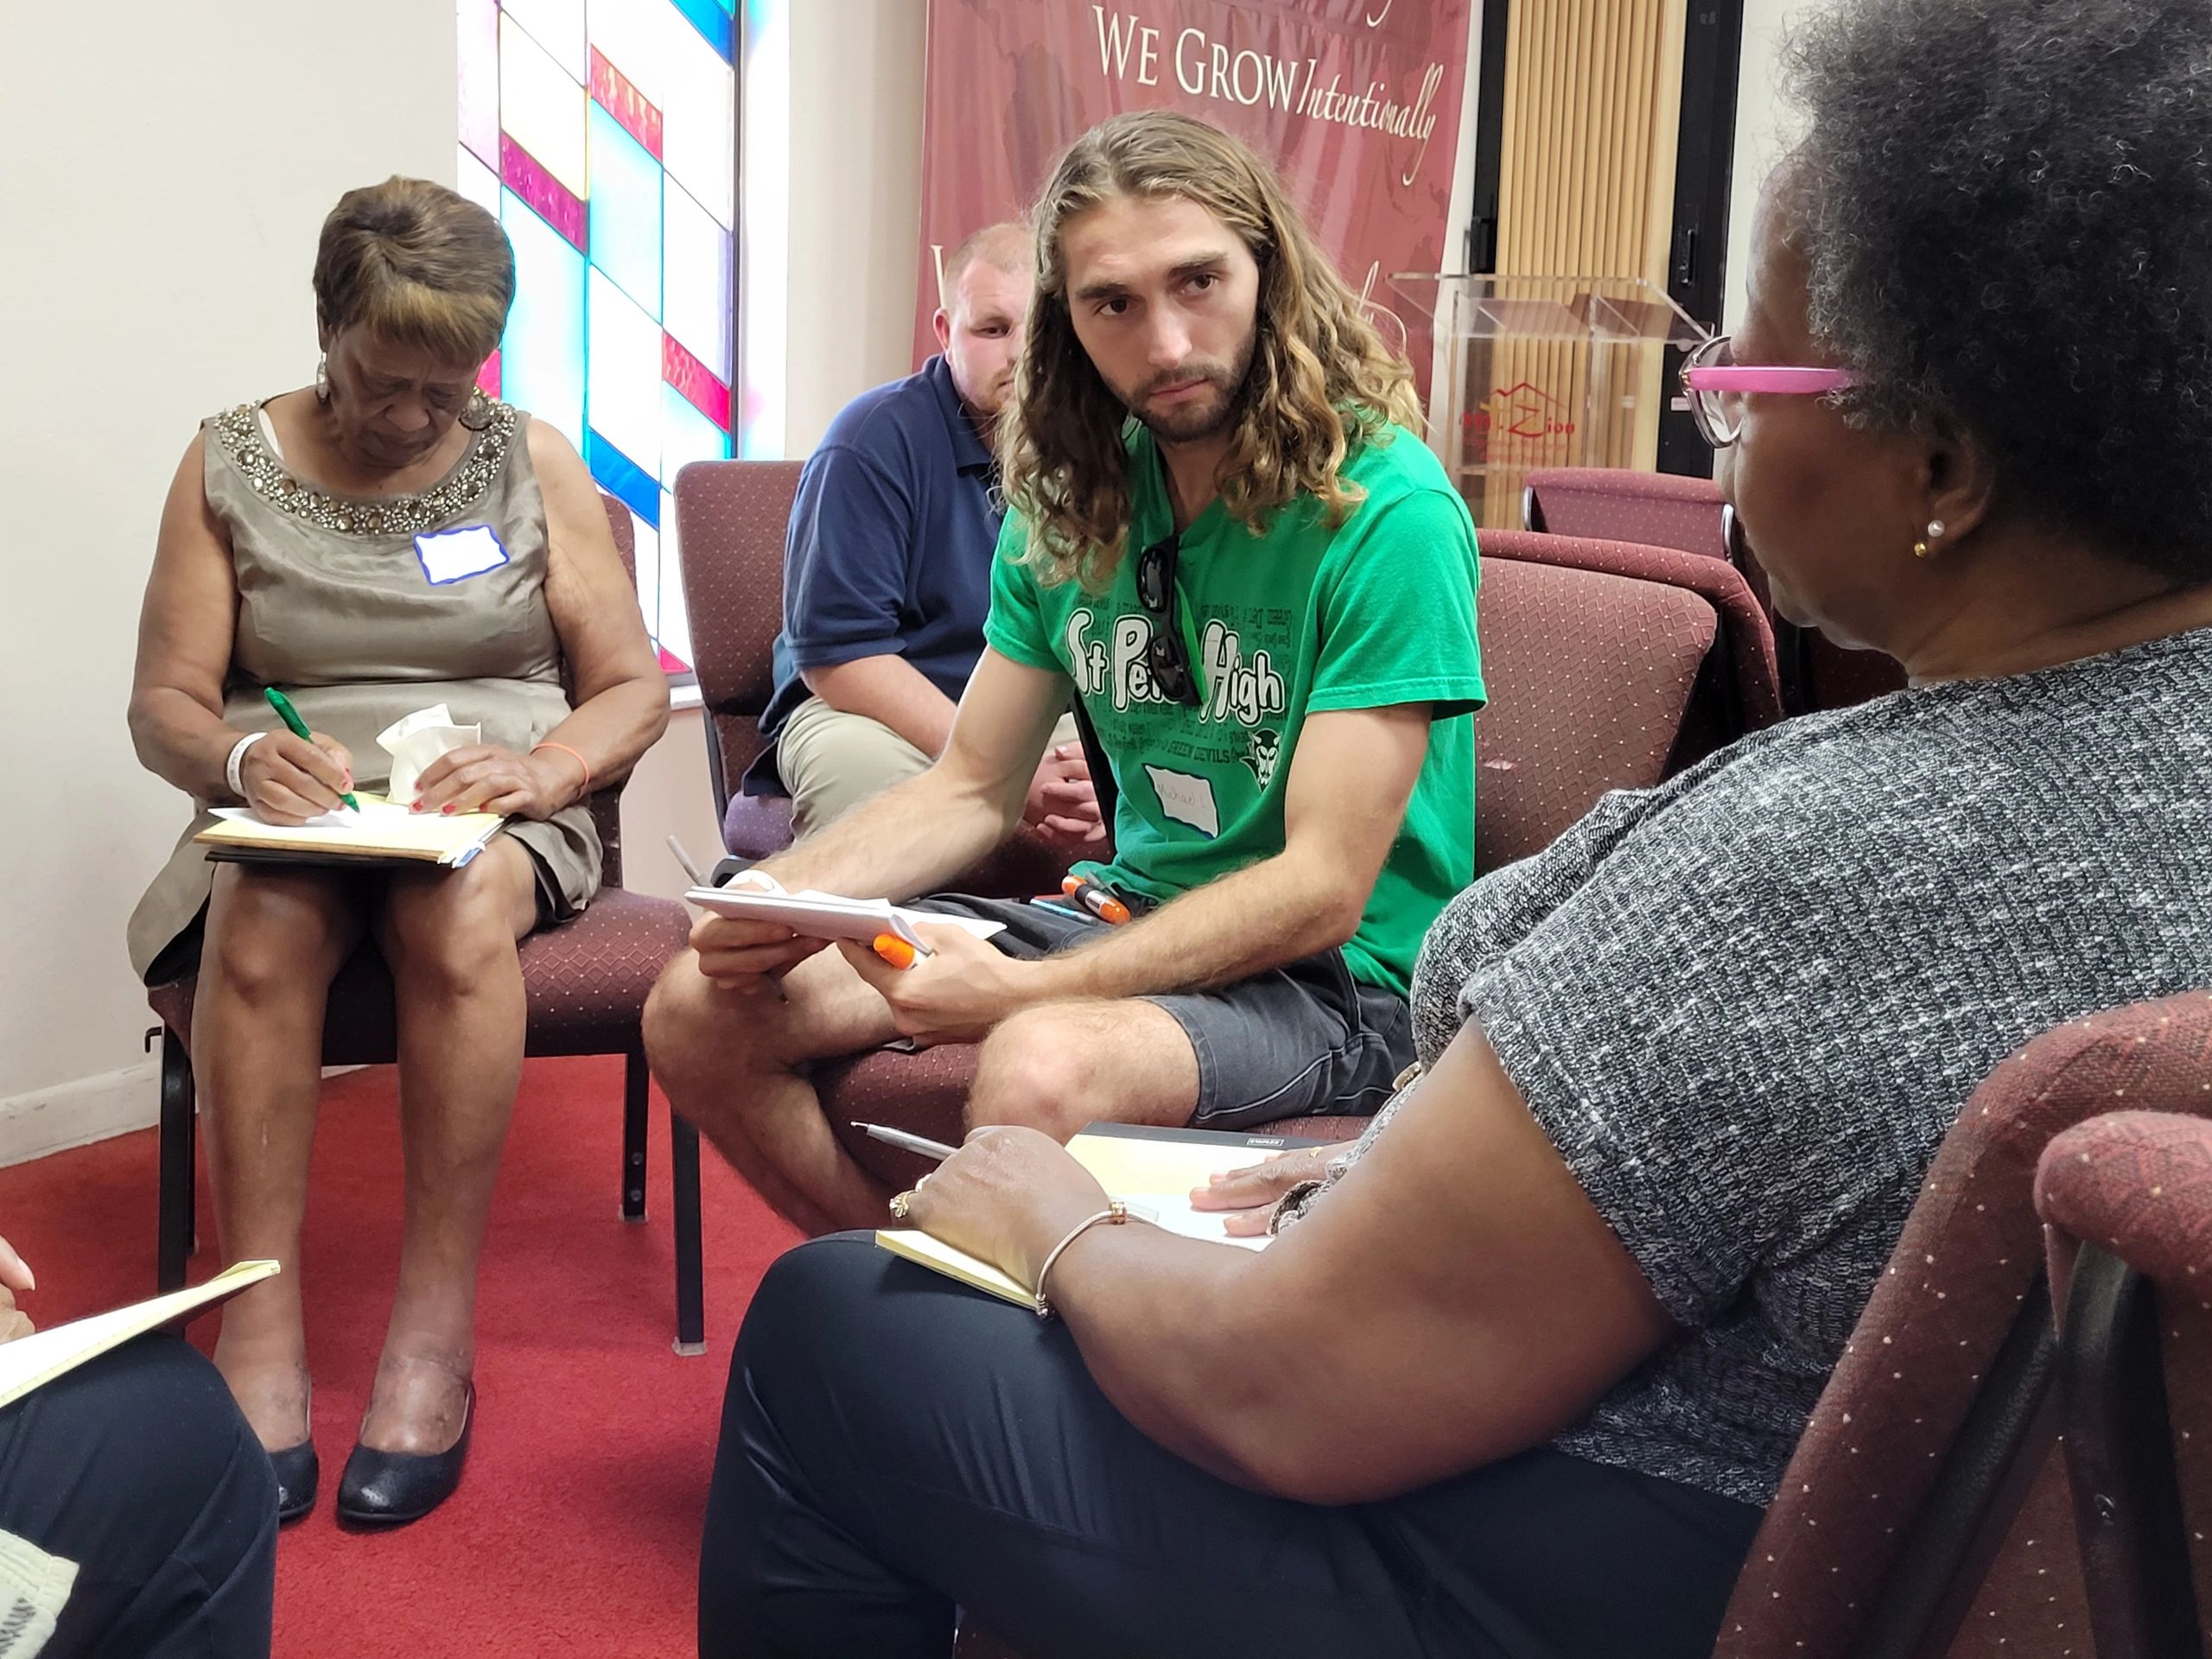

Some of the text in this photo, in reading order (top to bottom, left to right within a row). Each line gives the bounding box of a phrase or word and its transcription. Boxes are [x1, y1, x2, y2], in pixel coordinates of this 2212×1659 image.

[1092, 5, 1444, 186] WE GROW Intentionally
[1066, 607, 1108, 696] St
[1198, 619, 1285, 728] High
